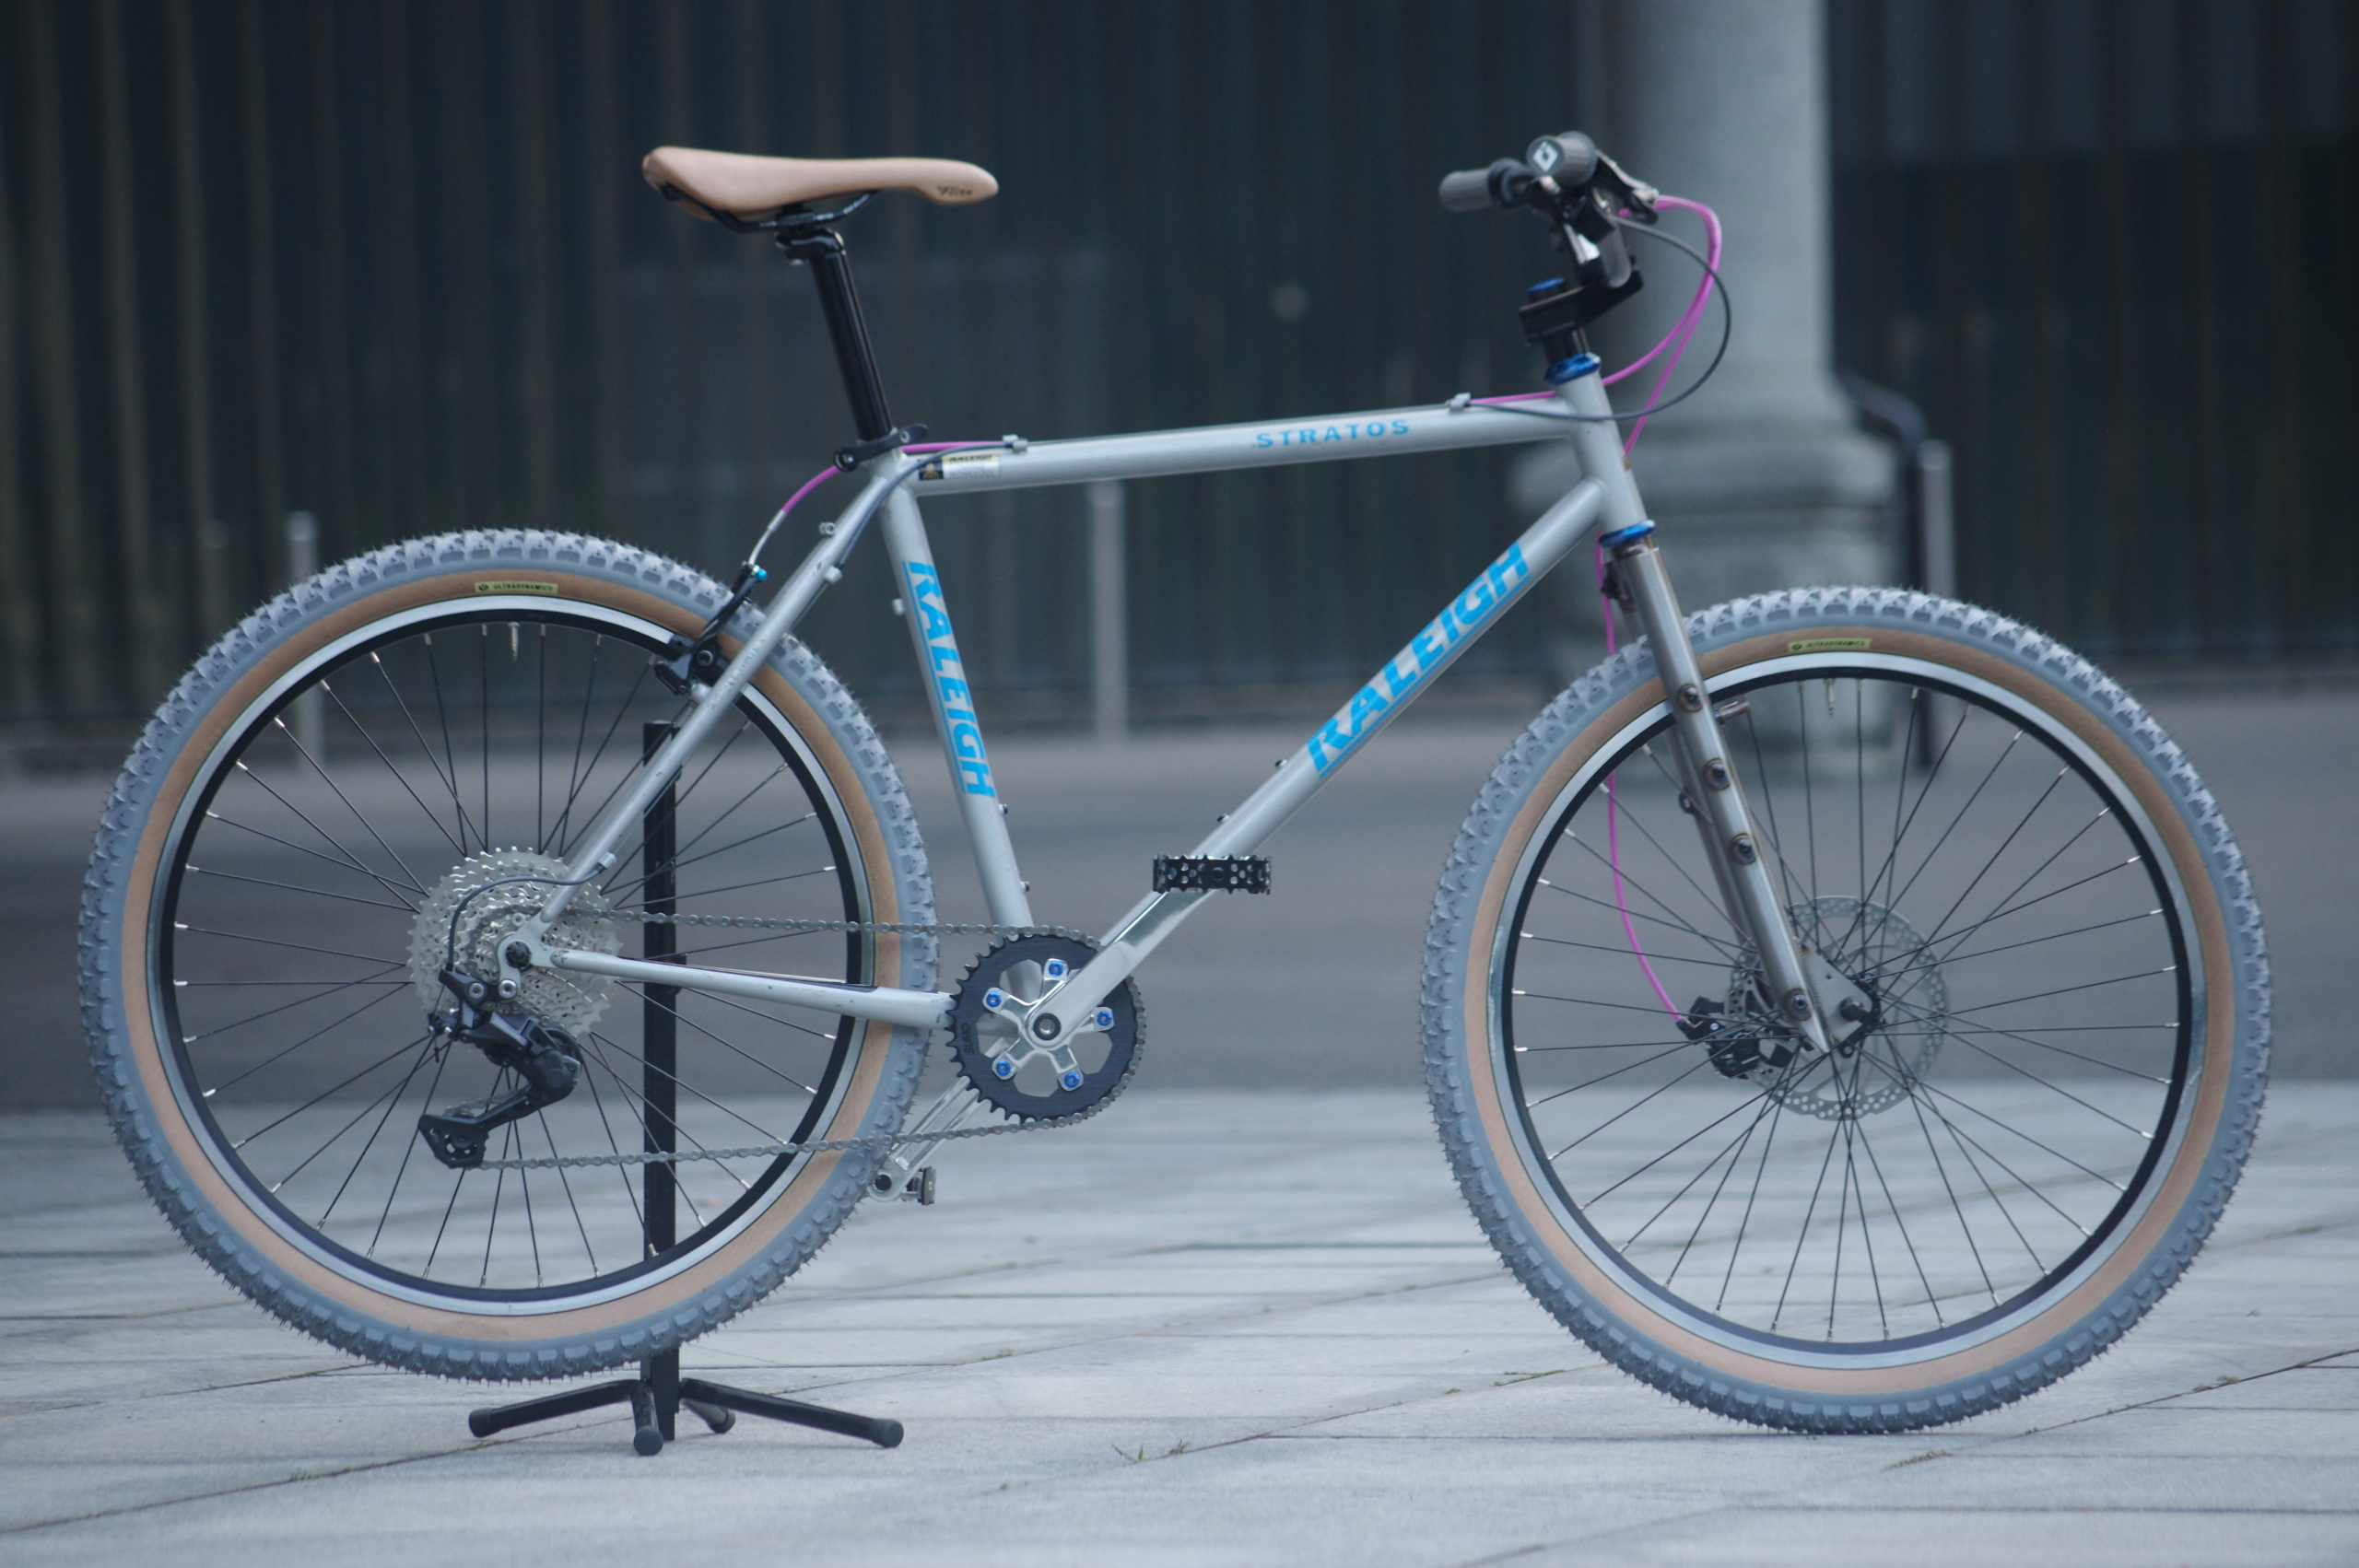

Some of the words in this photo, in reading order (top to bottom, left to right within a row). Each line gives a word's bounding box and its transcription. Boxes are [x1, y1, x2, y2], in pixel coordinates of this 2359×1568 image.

[1256, 420, 1409, 448] STRATOS
[493, 582, 553, 591] ULTRADYNAMICO
[909, 562, 996, 797] RALEIGH
[1307, 541, 1529, 772] RALEIGH
